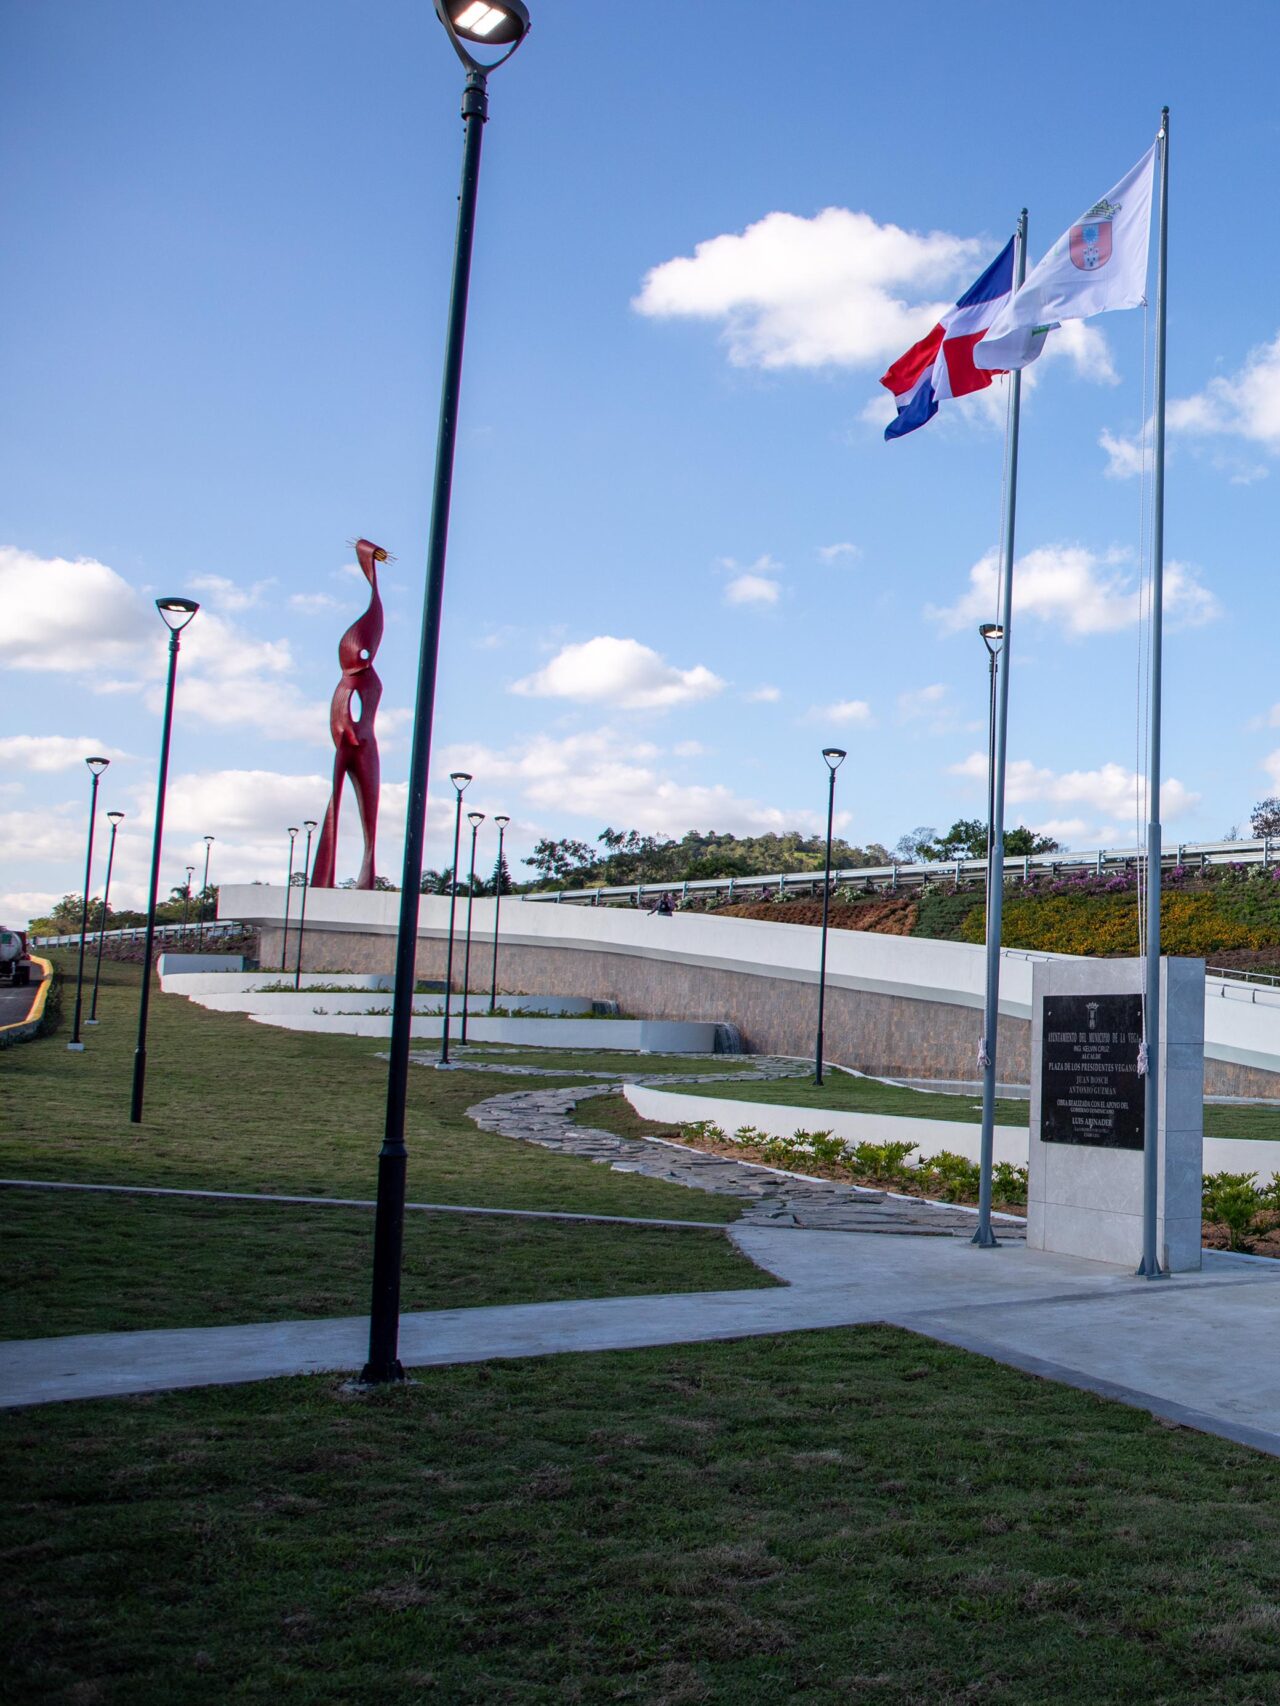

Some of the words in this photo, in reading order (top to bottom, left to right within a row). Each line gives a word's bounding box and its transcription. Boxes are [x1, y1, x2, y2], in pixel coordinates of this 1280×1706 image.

[1079, 1032, 1087, 1043] DEL
[1088, 1032, 1111, 1043] MUNICIPIO
[1112, 1032, 1118, 1043] DE
[1120, 1032, 1126, 1044] LA
[1048, 1062, 1063, 1071] PLAZA
[1064, 1062, 1070, 1071] DE
[1071, 1062, 1080, 1071] LOS
[1081, 1063, 1114, 1072] PRESIDENTES
[1114, 1063, 1139, 1073] VEGANO
[1076, 1075, 1090, 1084] JUAN
[1090, 1075, 1109, 1085] BOSCH
[1068, 1085, 1094, 1094] ANTONIO
[1068, 1099, 1090, 1108] REALIZADA
[1072, 1117, 1085, 1125] LUIS
